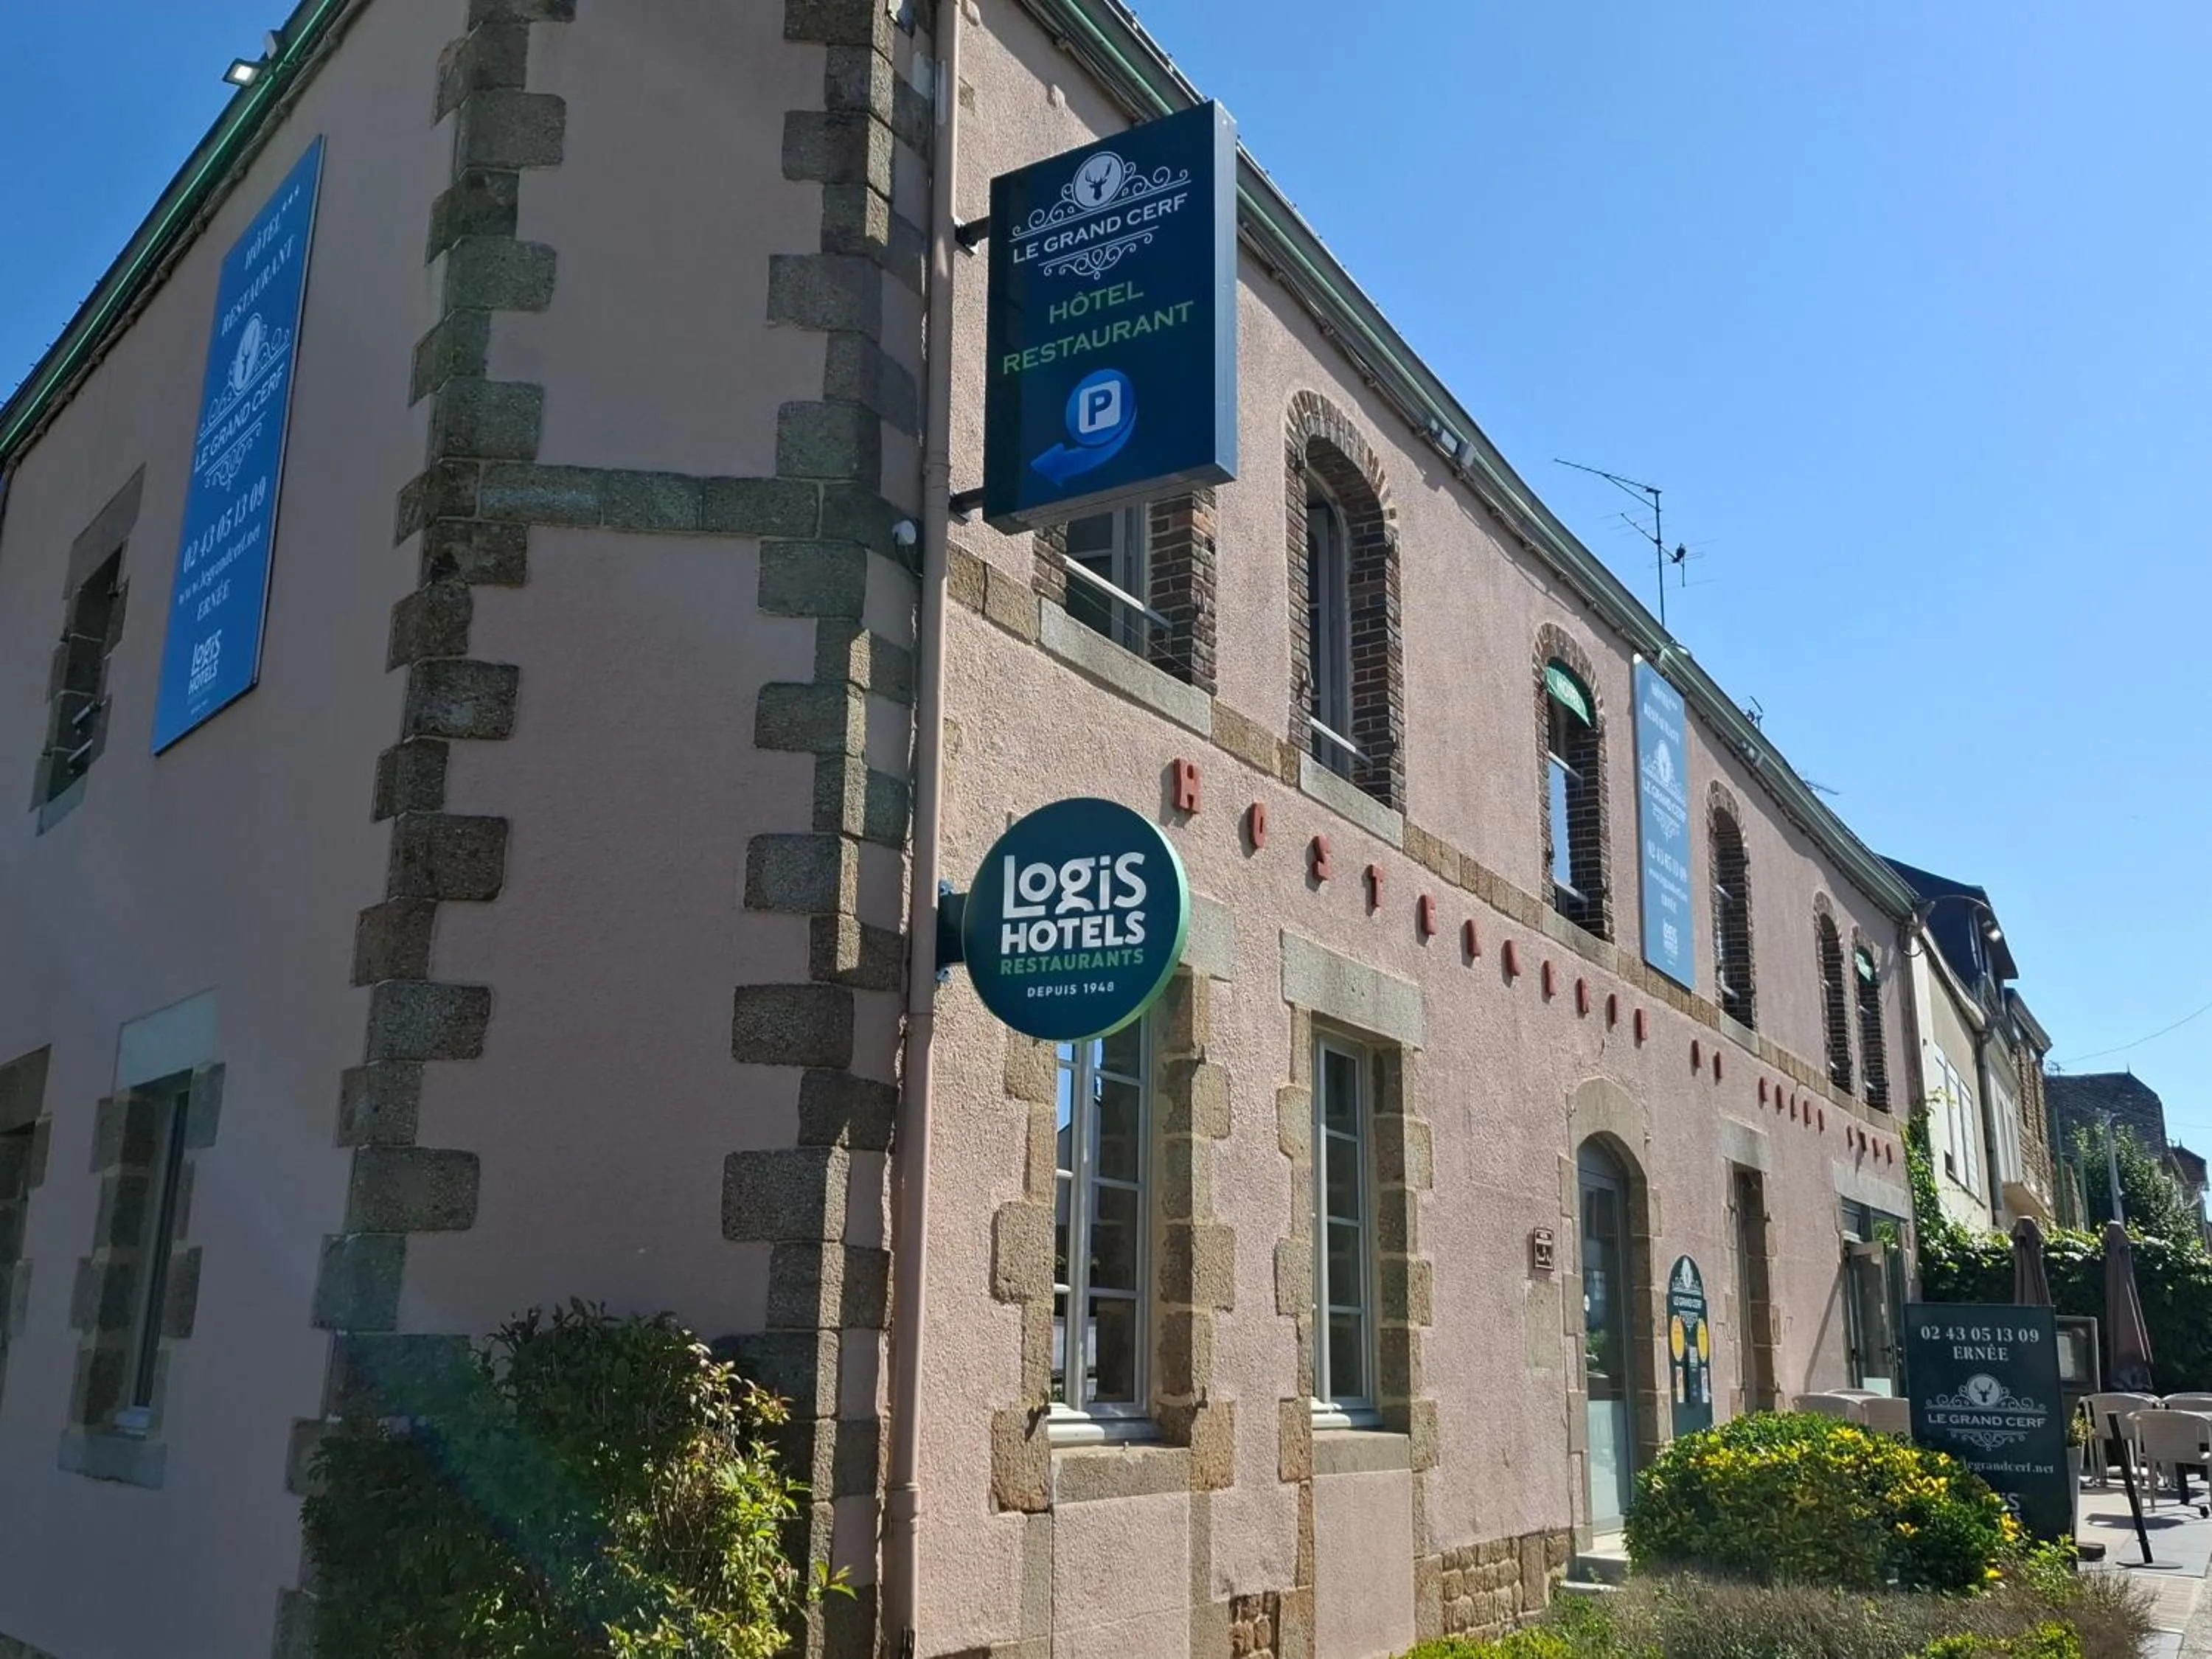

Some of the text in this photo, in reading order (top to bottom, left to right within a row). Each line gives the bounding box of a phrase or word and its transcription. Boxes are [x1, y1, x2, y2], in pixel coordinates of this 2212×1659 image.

[1013, 192, 1188, 263] LE GRAND CERF
[1048, 281, 1144, 324] HÔTEL
[1003, 301, 1194, 375] RESTAURANT
[194, 362, 285, 473] LE GRAND CERF
[184, 476, 266, 573] 02 43 05 13 09
[1001, 911, 1146, 955] HOTELS
[1001, 948, 1144, 975] RESTAURANTS
[1027, 981, 1114, 998] DEPUIS 1948
[1921, 1326, 2039, 1343] 02 43 05 13 09
[1927, 1413, 2047, 1428] LE GRAND CERF
